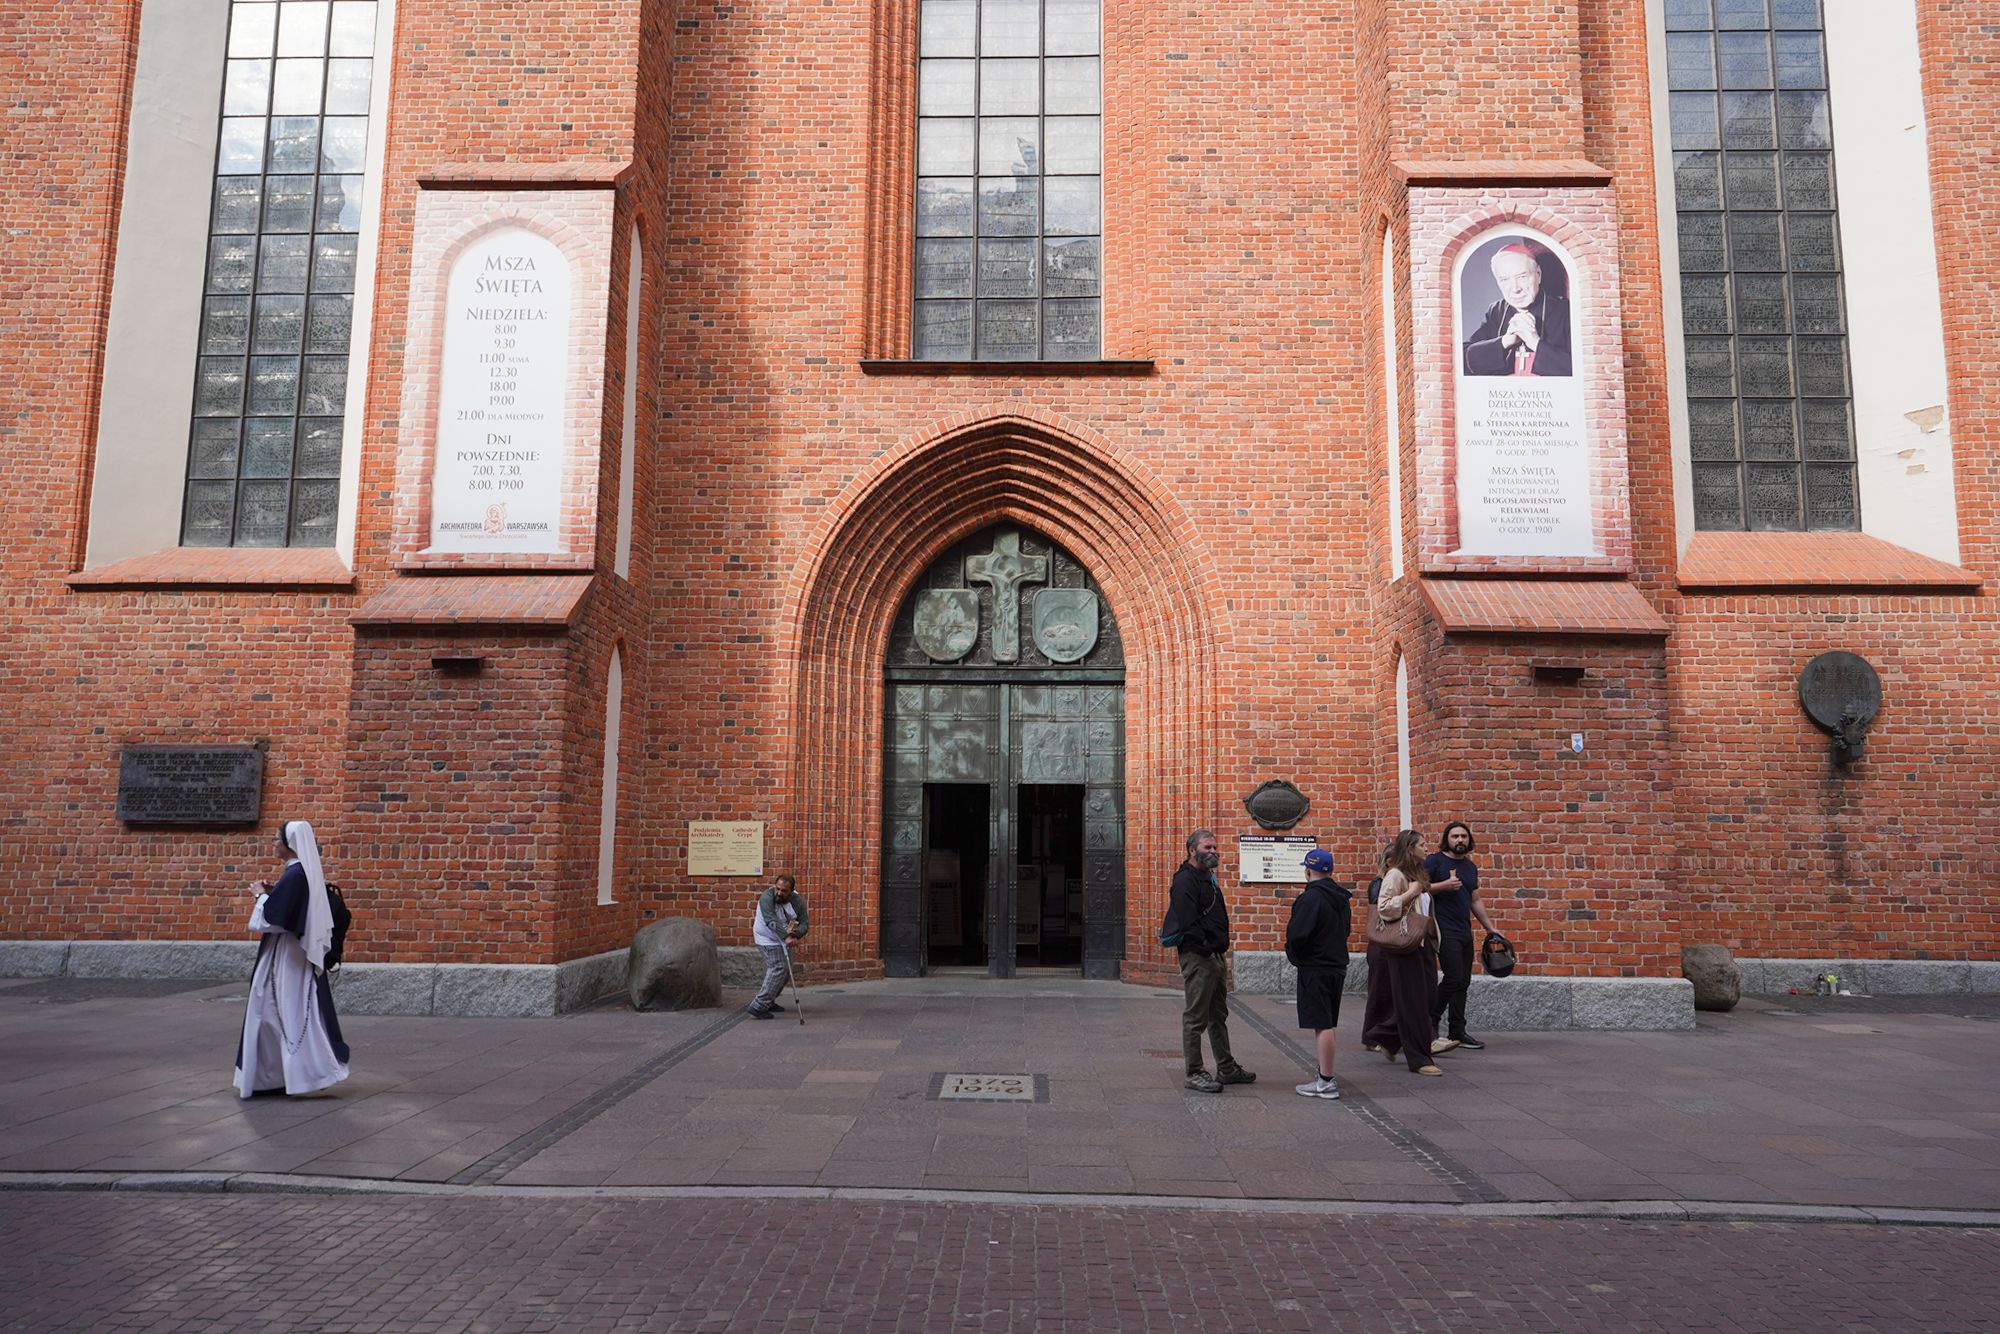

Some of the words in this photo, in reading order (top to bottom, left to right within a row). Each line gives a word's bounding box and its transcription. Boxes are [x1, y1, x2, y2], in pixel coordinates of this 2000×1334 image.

[484, 255, 536, 271] MSZA
[474, 273, 543, 297] ŚWIĘTA
[466, 307, 548, 321] NIEDZIELA:
[494, 324, 517, 334] 8.00
[494, 339, 516, 349] 9.30
[479, 353, 505, 363] 11.00
[490, 367, 517, 377] 12.30
[489, 382, 516, 391] 18.00
[1488, 390, 1515, 399] MSZA
[489, 395, 515, 406] 19.00
[457, 410, 485, 421] 21.00
[486, 433, 512, 445] DNI
[456, 451, 540, 462] POWSZEDNIE:
[1491, 466, 1518, 475] MSZA
[498, 480, 524, 490] 19.00
[440, 522, 483, 530] ARCHIKATEDRA
[506, 522, 548, 530] WARSZAWSKA
